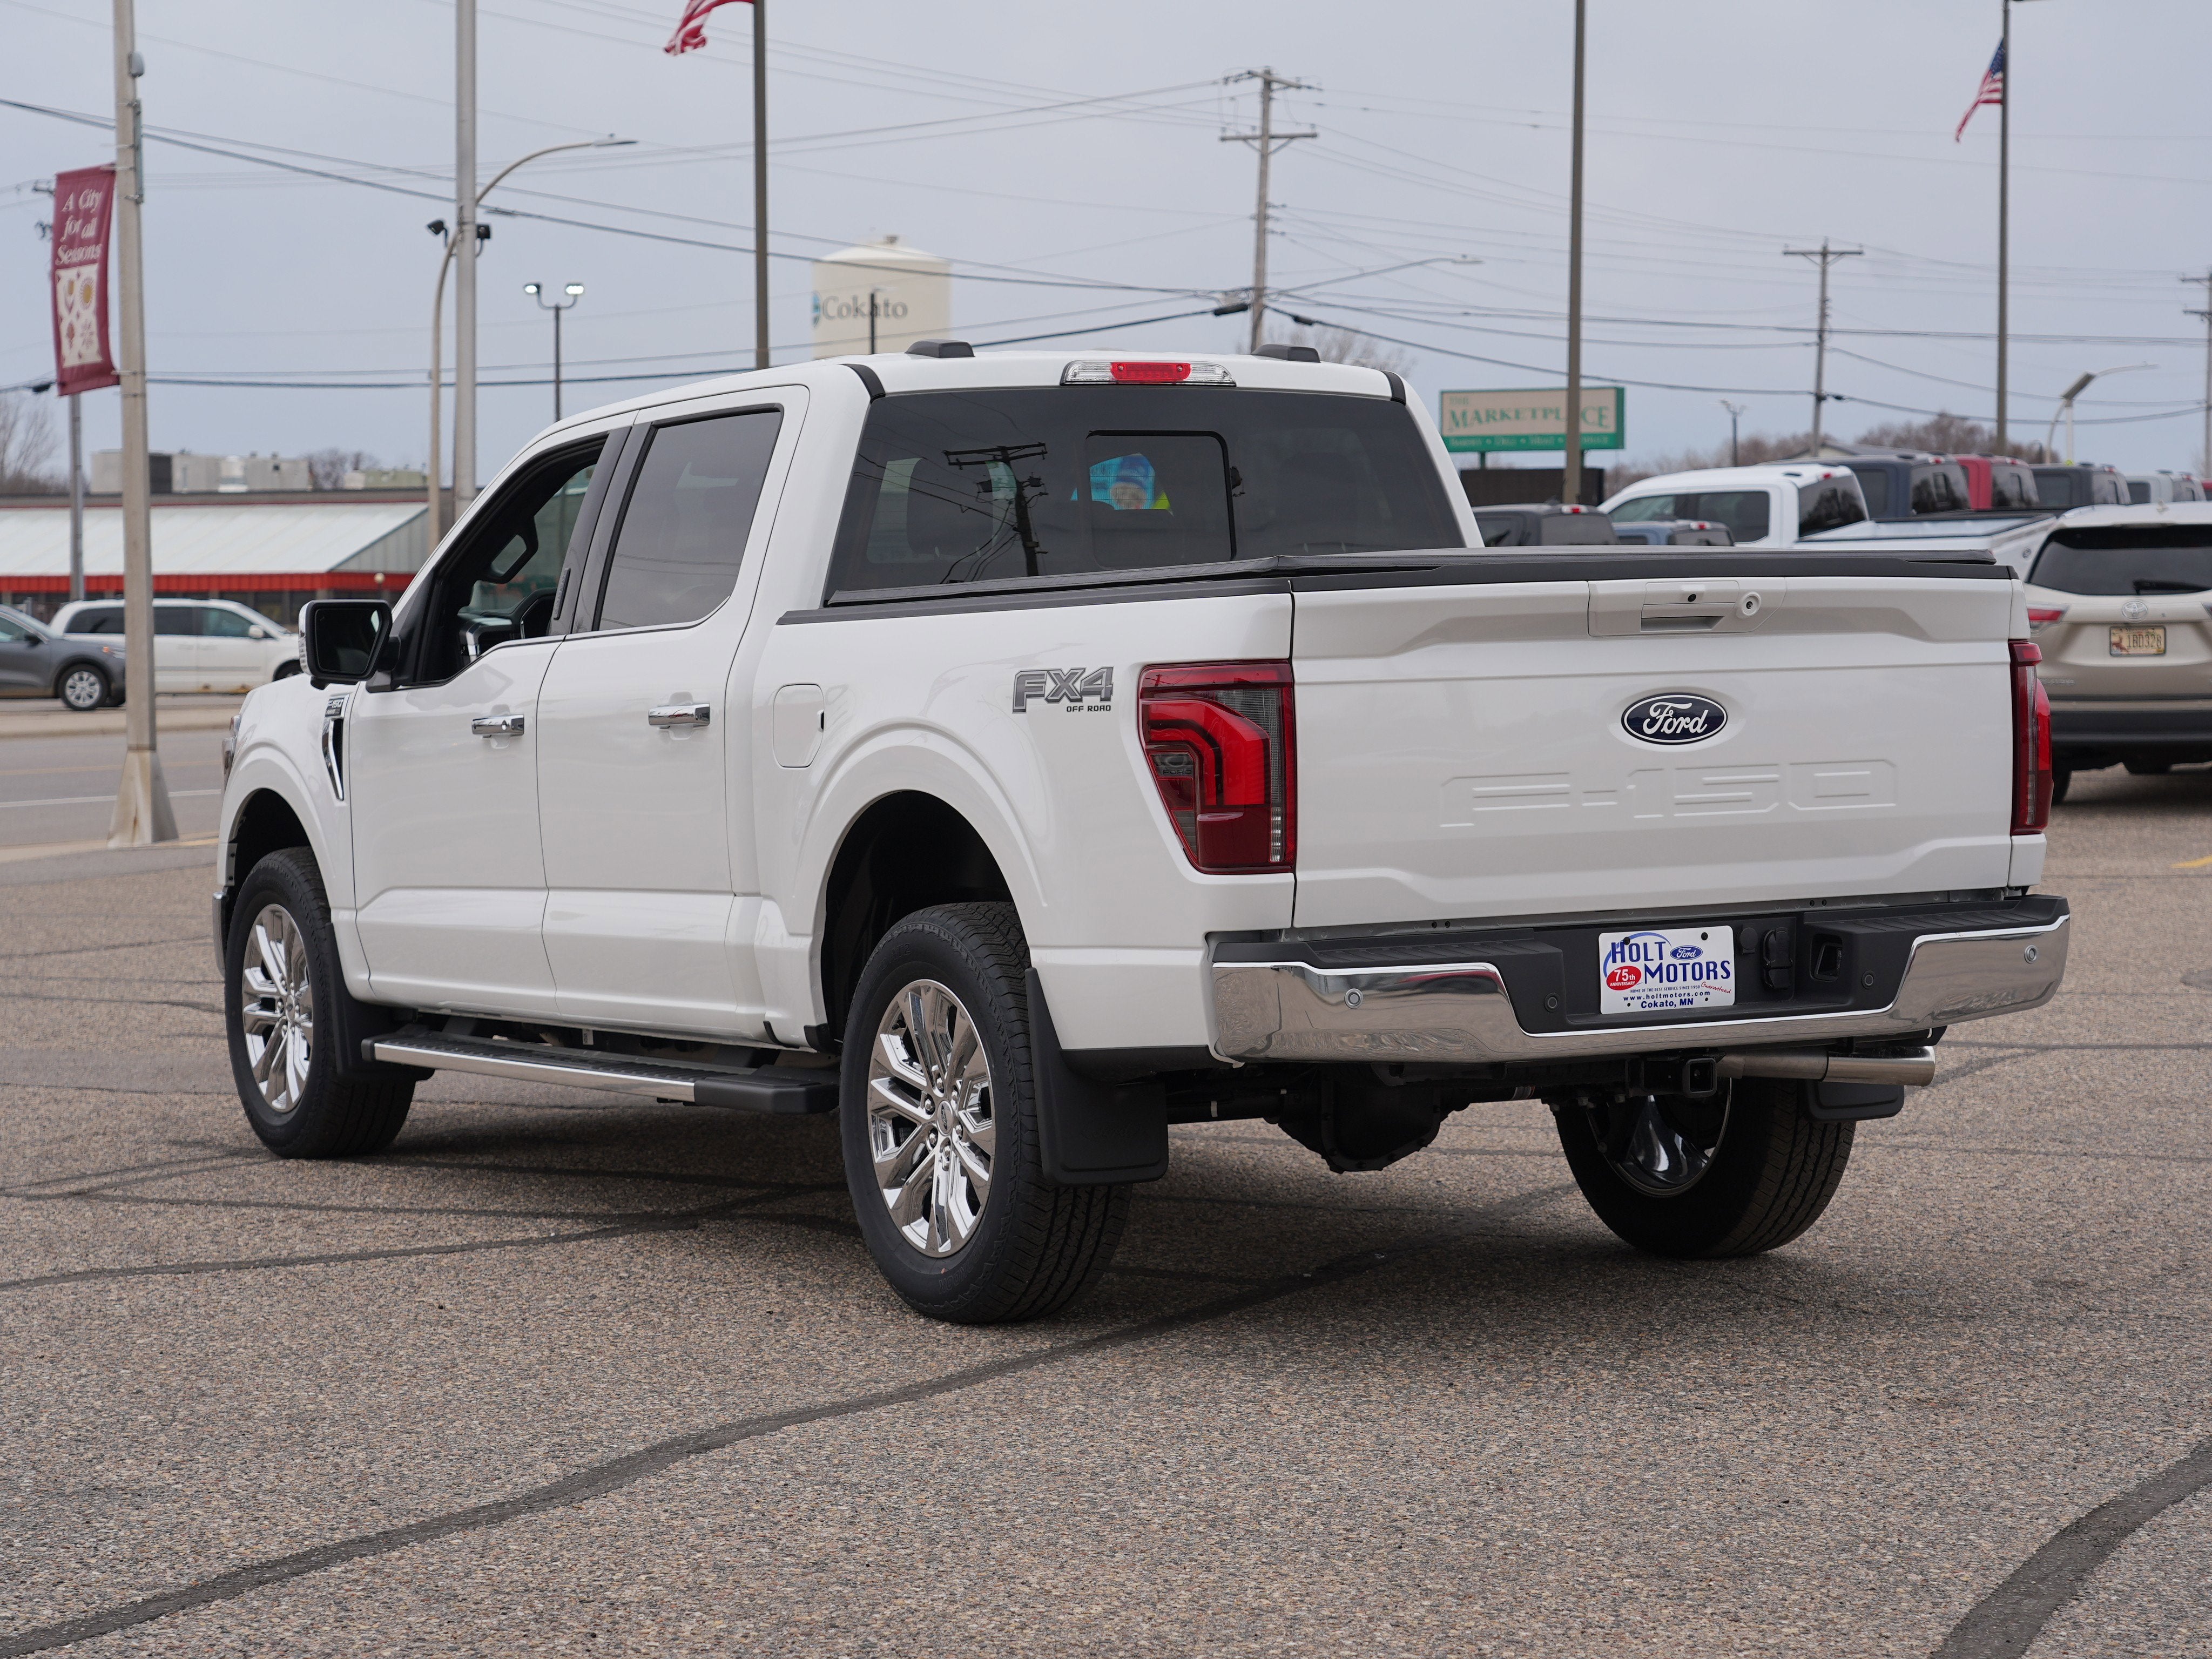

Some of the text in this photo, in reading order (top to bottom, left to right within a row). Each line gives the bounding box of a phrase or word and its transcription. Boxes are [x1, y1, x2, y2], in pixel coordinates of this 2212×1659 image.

[60, 188, 103, 214] A City
[59, 215, 97, 242] for all
[1448, 405, 1611, 433] MARKETPLCE
[1012, 666, 1115, 714] FX4
[1643, 701, 1708, 735] Ford
[1439, 759, 1897, 828] F-150
[1611, 941, 1666, 963] HOLT
[1676, 947, 1696, 959] Ford
[1614, 969, 1636, 982] 75th
[1644, 960, 1731, 984] MOTORS
[1623, 991, 1710, 1001] www.holtmotors.com
[1701, 981, 1731, 994] Guaranteed
[1641, 1000, 1676, 1009] Cokato,
